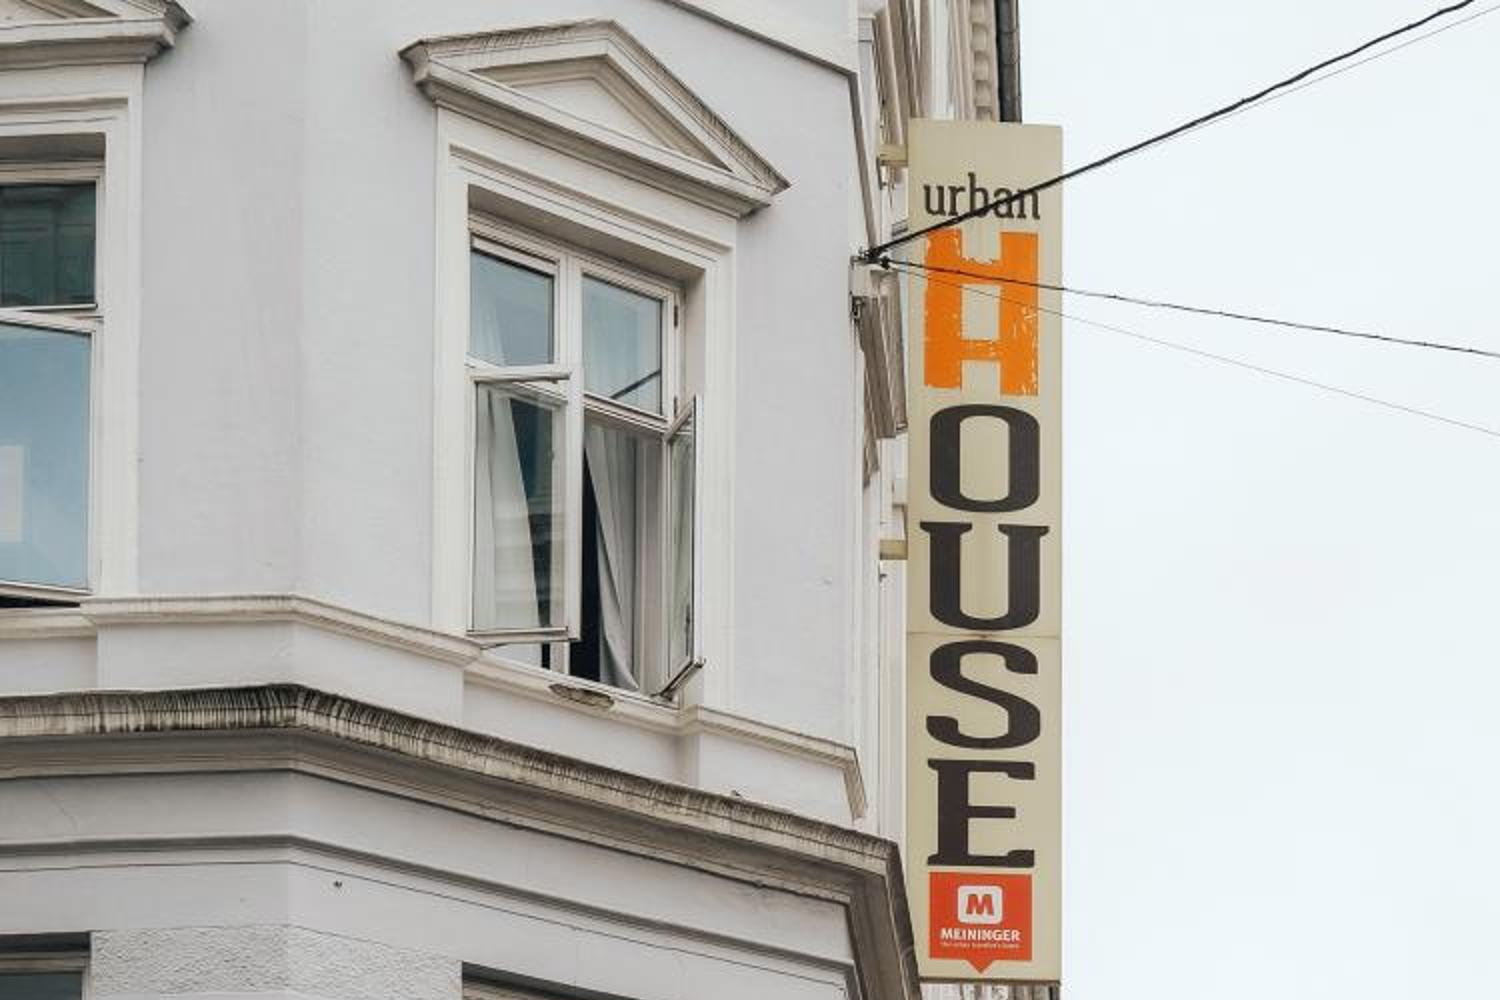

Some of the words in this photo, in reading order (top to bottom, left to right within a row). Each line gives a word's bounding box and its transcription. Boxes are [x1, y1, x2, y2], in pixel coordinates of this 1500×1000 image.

[923, 171, 1040, 220] urban
[919, 228, 1050, 868] HOUSE
[965, 893, 995, 915] M
[941, 927, 1021, 941] MEININGER
